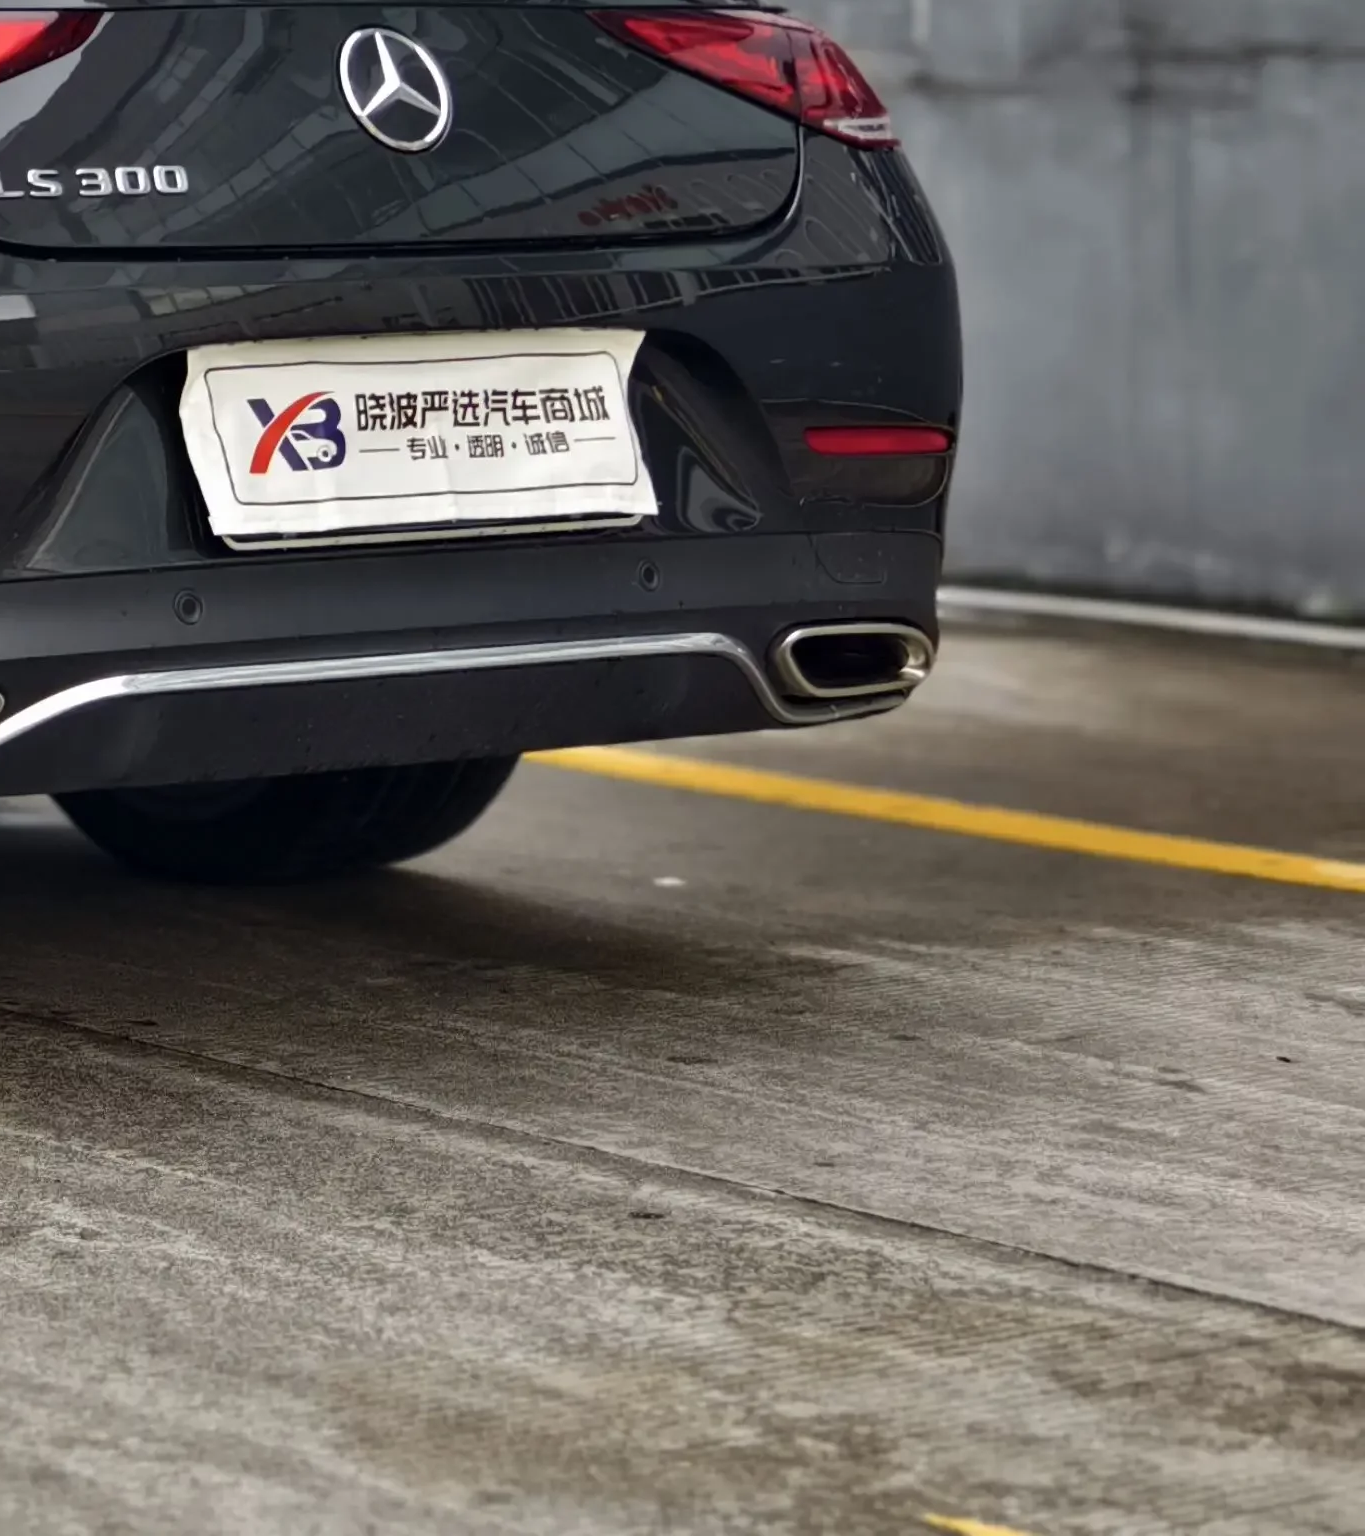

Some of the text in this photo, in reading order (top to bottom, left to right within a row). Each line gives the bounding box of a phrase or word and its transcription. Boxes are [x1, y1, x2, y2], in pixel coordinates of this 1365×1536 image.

[75, 165, 189, 196] 300
[354, 385, 611, 432] 晓波严选汽车商城
